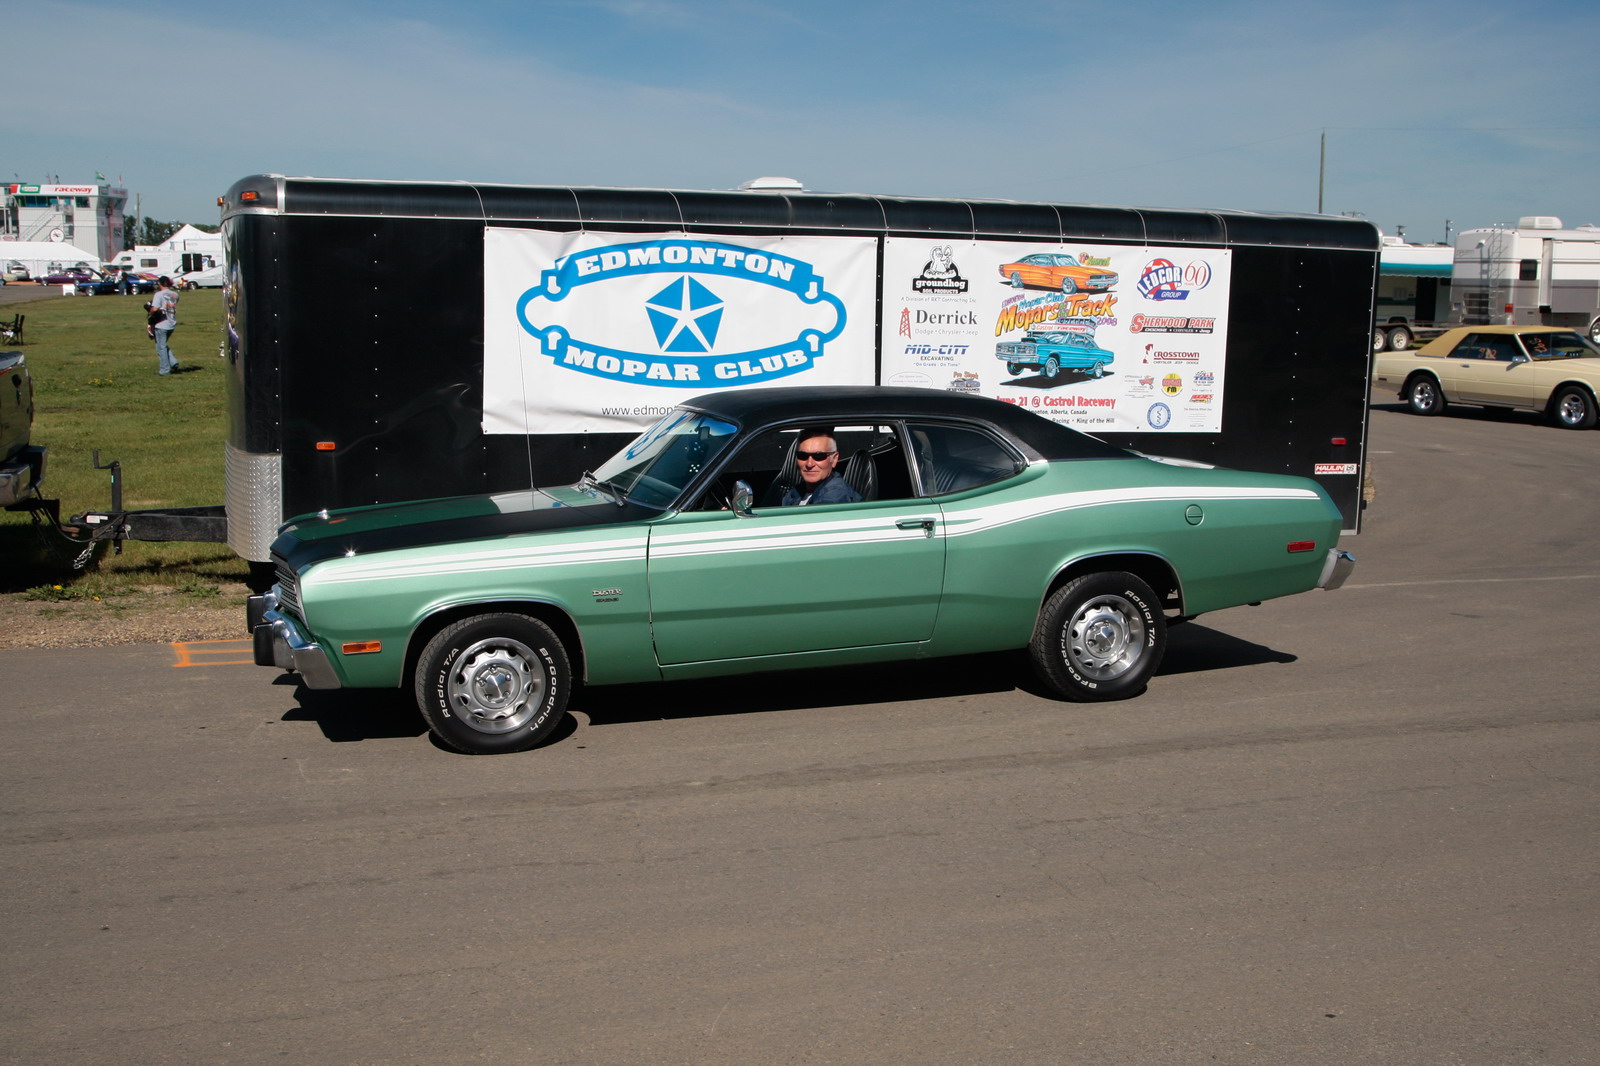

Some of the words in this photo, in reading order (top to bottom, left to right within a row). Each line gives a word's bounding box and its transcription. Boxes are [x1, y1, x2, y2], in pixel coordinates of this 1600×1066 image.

[54, 186, 93, 194] raceway
[575, 246, 795, 282] EDMONTON
[915, 278, 966, 290] groundhog
[1137, 267, 1182, 296] LEDCOR
[1184, 265, 1207, 286] 60
[915, 309, 978, 325] Derrick
[995, 303, 1060, 337] Mopars
[1064, 293, 1118, 317] Track
[1130, 314, 1187, 333] SHERWOOD
[1188, 318, 1214, 328] PARK
[914, 328, 934, 336] Dodge
[938, 328, 962, 337] Chrysler
[904, 344, 969, 355] MID-CITY
[1153, 351, 1200, 359] CROSSTOWN
[563, 344, 702, 381] MOPAR
[714, 349, 808, 380] CLUB
[1018, 396, 1028, 407] 21
[1031, 395, 1041, 408] @
[1043, 395, 1076, 407] Castrol
[1077, 396, 1117, 409] Raceway
[1148, 627, 1157, 647] T/A
[443, 647, 460, 667] T/A
[1060, 620, 1098, 690] BFGoodrich
[529, 647, 557, 732] BFGoodrich
